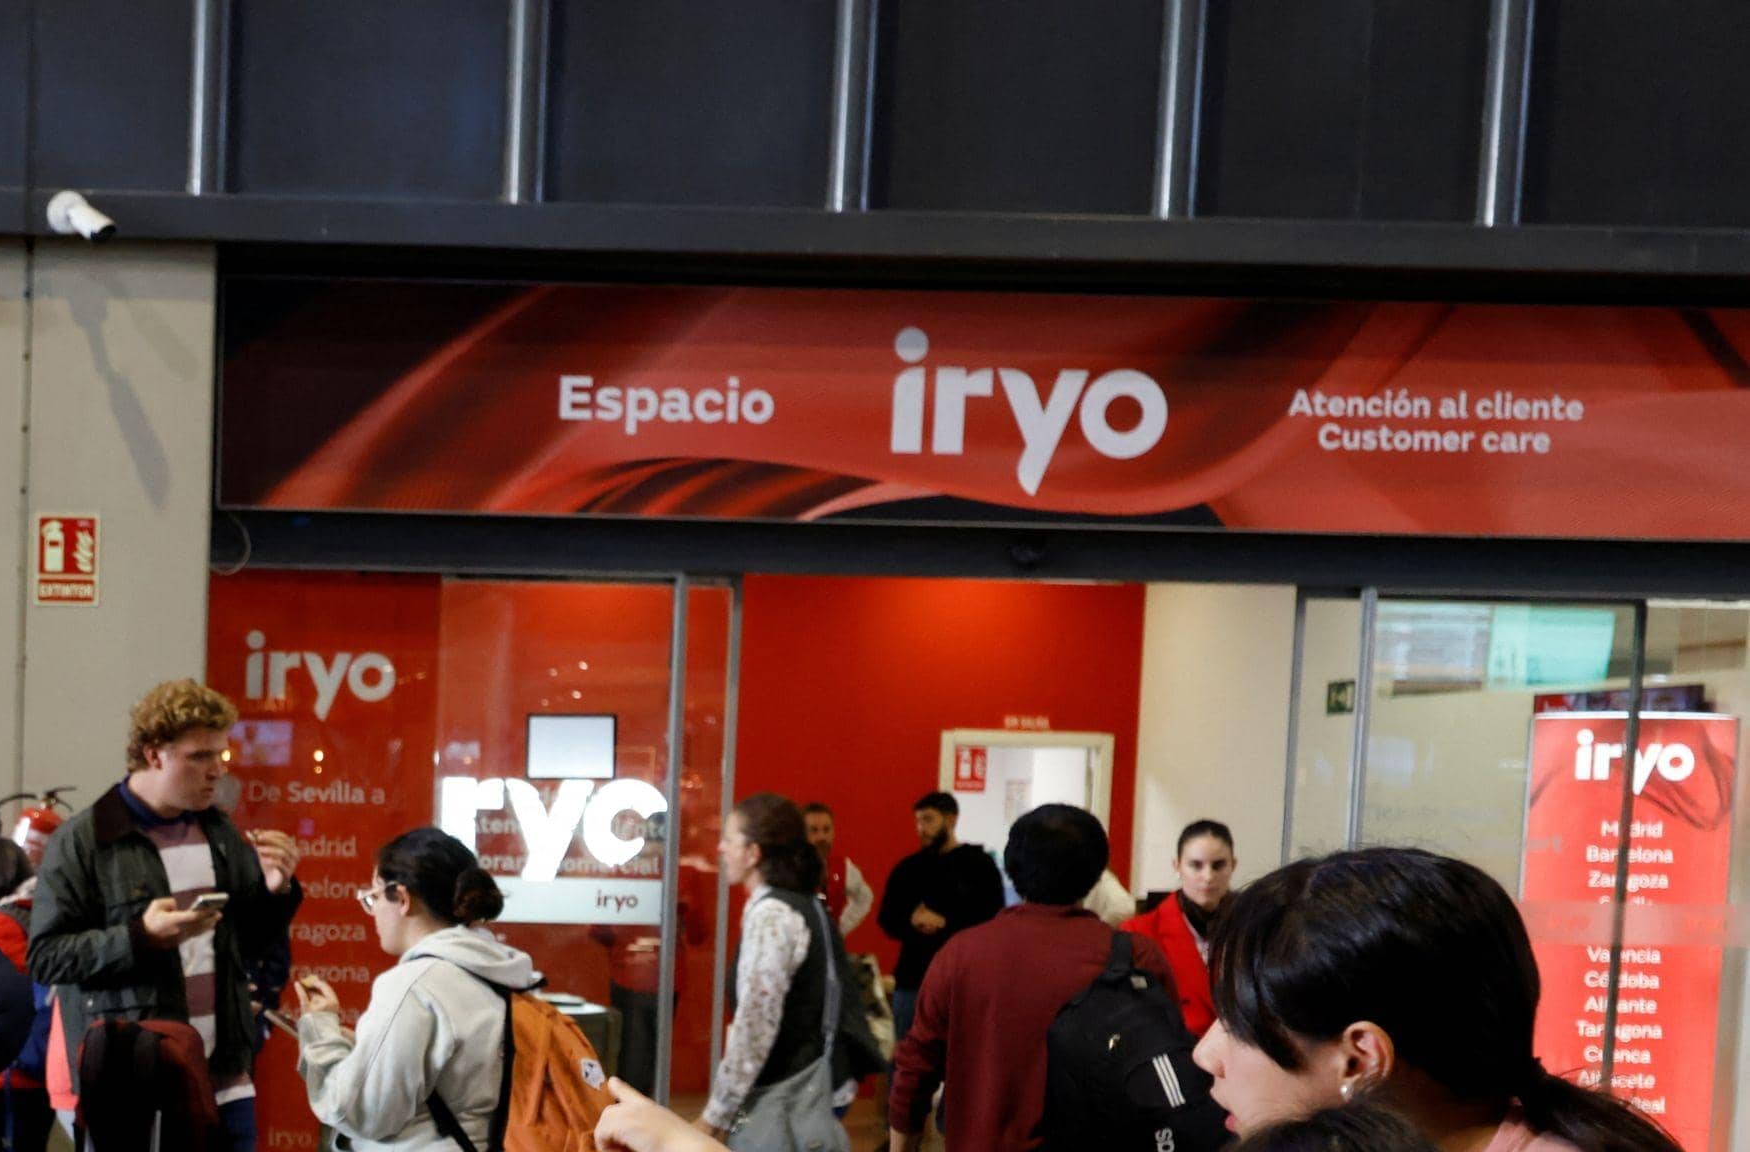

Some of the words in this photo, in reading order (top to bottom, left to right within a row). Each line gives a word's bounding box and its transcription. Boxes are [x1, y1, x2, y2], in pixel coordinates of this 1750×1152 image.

[559, 375, 775, 435] Espacio
[891, 327, 1169, 497] iryo
[1289, 388, 1432, 419] Atención
[1438, 390, 1469, 420] al
[1475, 390, 1585, 422] cliente
[1317, 422, 1476, 453] Customer
[1481, 430, 1551, 454] care
[246, 630, 397, 721] iryo
[1574, 728, 1696, 796] iryo
[249, 780, 281, 803] De
[287, 779, 366, 804] Sevilla
[371, 786, 386, 804] a
[1601, 820, 1664, 838] Mdrid
[291, 835, 358, 857] adrid
[1586, 845, 1674, 864] Barelona
[596, 889, 639, 913] iryo
[290, 922, 367, 947] ragoza
